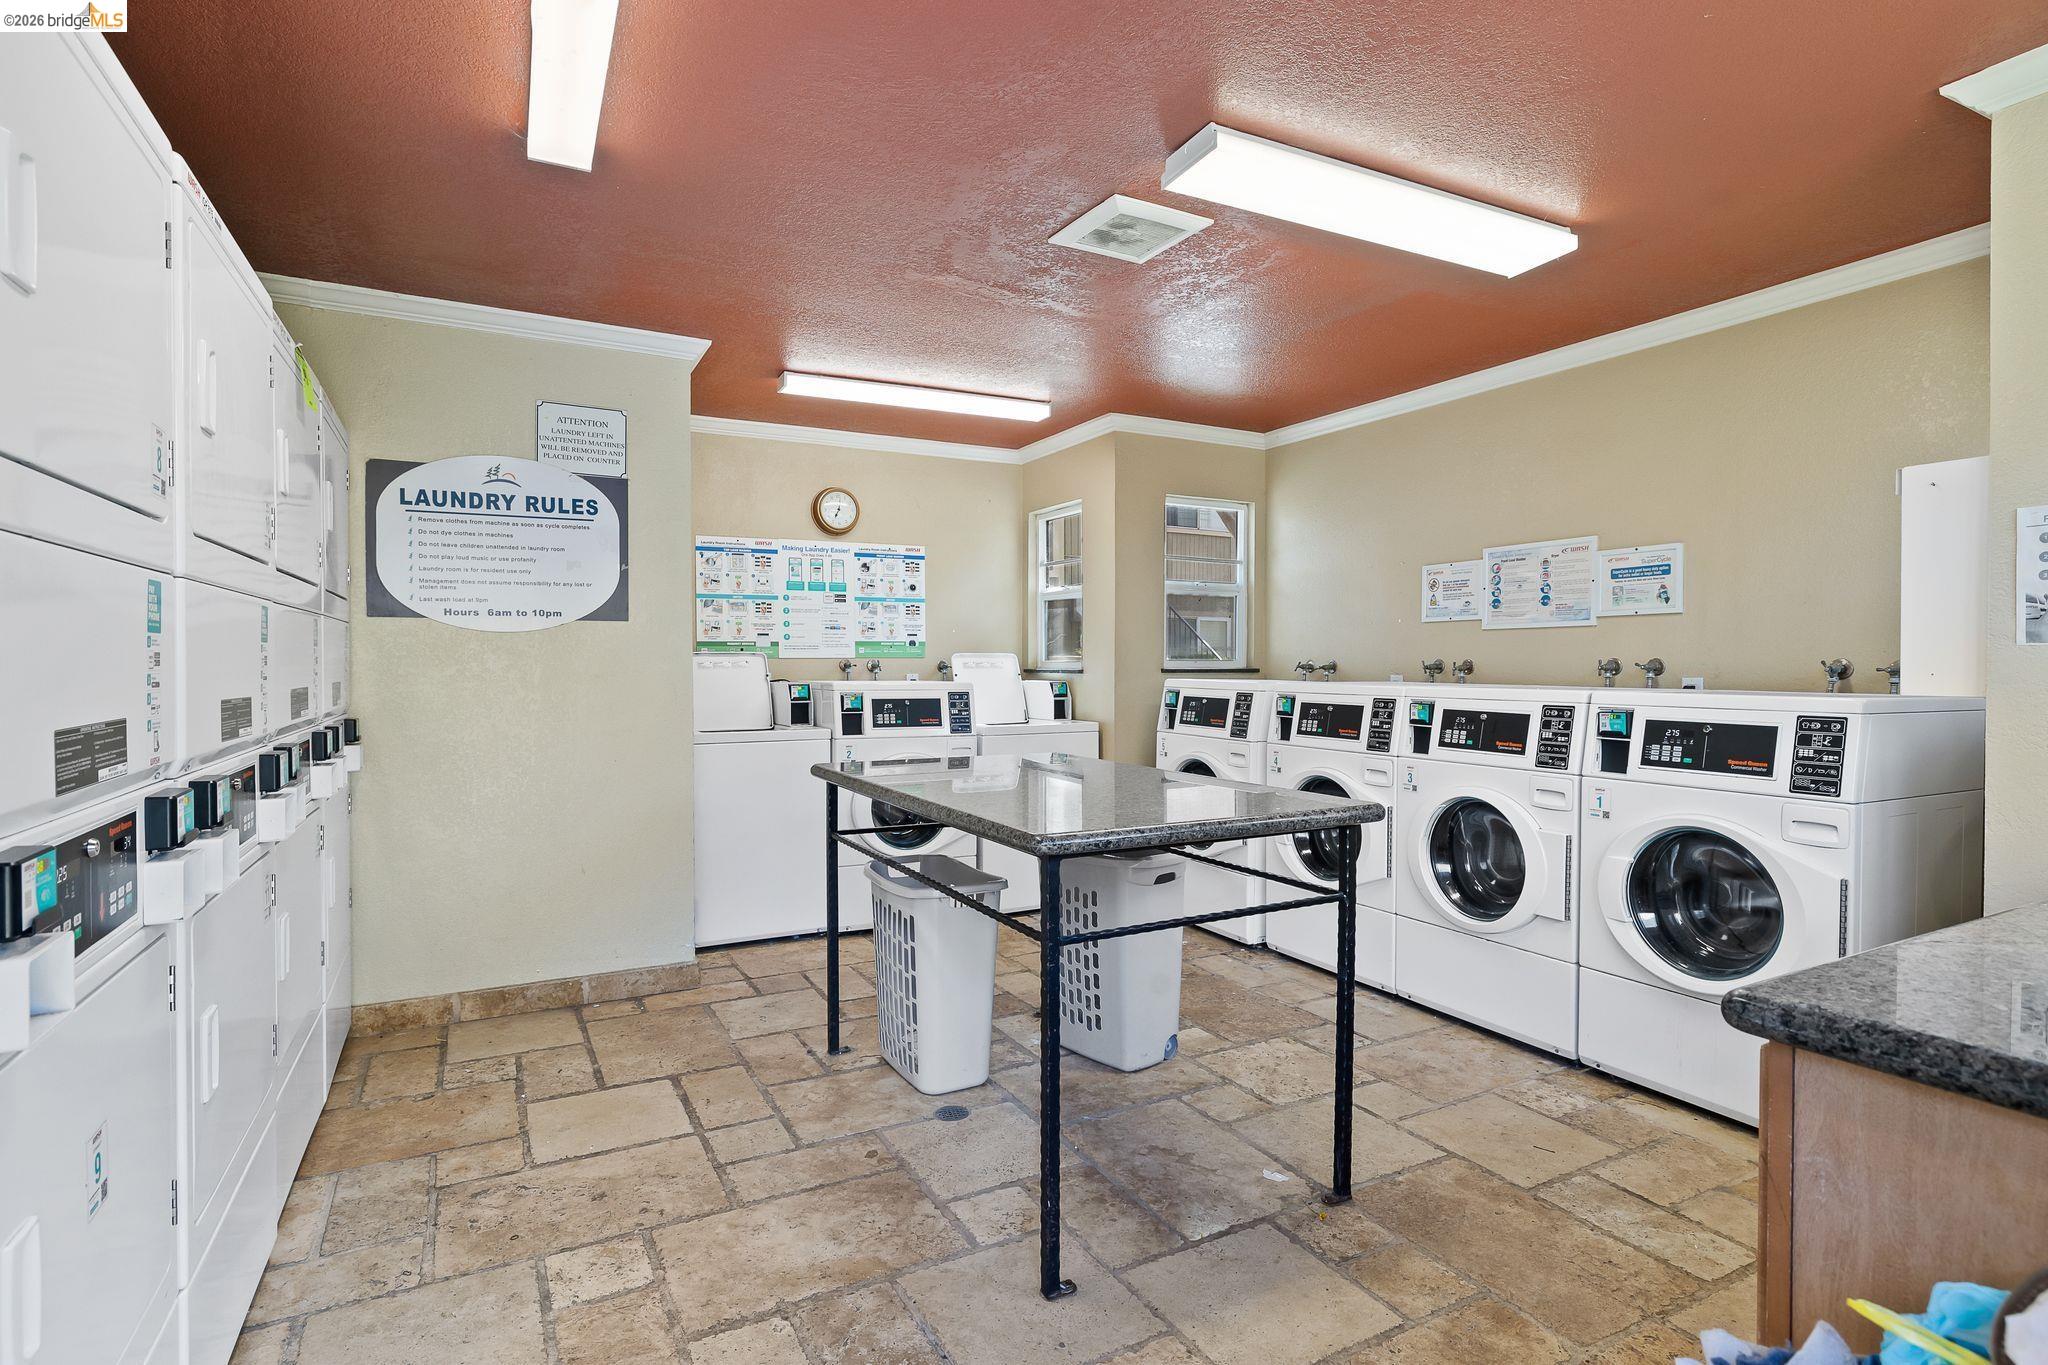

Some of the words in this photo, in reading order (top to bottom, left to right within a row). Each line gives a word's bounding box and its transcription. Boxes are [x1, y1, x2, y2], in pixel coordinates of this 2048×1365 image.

[557, 416, 609, 429] ATTENTION
[551, 428, 586, 437] LAUNDRY
[539, 435, 587, 445] UNATTENTED
[588, 440, 625, 449] MACHINES
[540, 443, 559, 451] WILL
[572, 447, 607, 456] REMOVED
[543, 452, 572, 460] PLACED
[587, 457, 621, 465] COUNTER
[400, 487, 516, 511] LAUNDRY
[525, 495, 599, 516] RULES
[444, 608, 479, 616] Hours
[488, 608, 512, 617] 6am
[516, 609, 528, 617] to
[532, 609, 562, 618] 10pm
[847, 751, 852, 759] 2
[1408, 772, 1413, 783] 3
[1597, 796, 1601, 808] 1
[95, 1152, 101, 1184] 9
